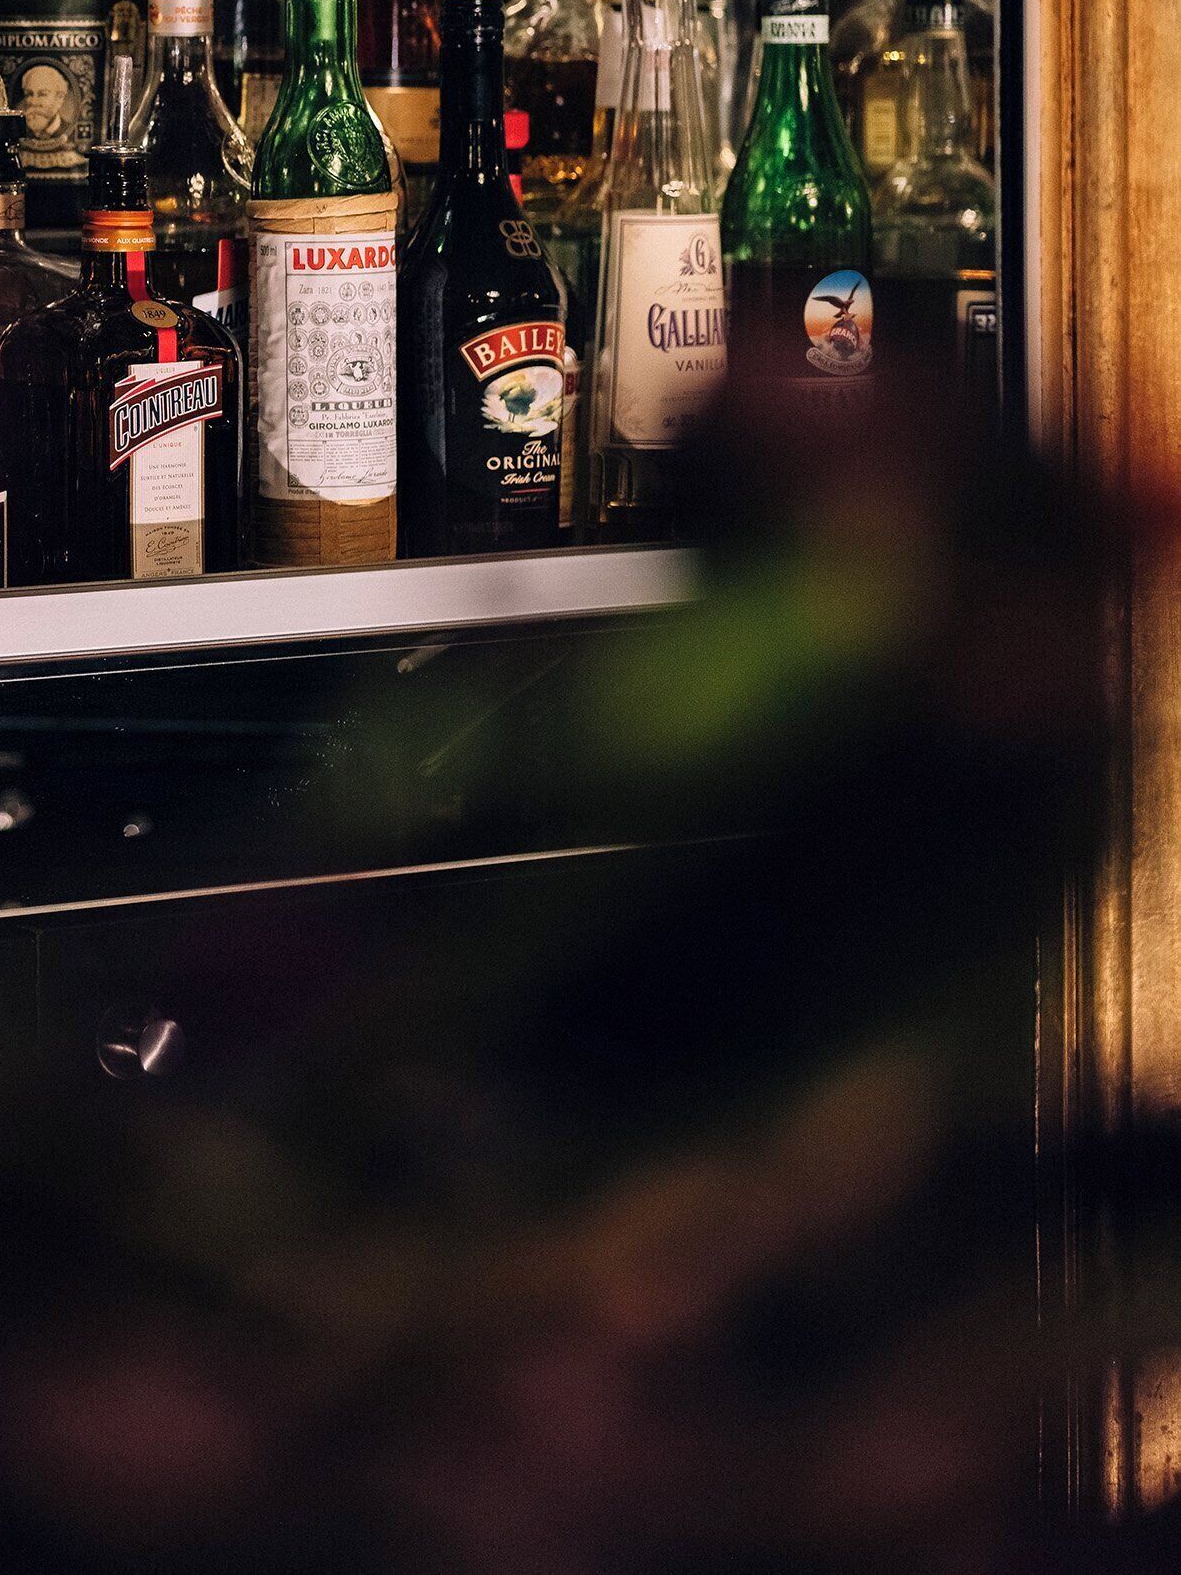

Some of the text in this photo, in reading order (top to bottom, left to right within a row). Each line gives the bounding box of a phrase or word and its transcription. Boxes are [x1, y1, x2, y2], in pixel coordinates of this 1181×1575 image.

[143, 309, 167, 319] 1849
[312, 397, 392, 412] LIQUEUR
[114, 376, 217, 452] COINTREAU
[309, 418, 394, 430] GIROLAMO LUXARDO
[522, 440, 547, 456] The
[486, 453, 561, 471] ORIGINAL
[500, 473, 531, 486] Irish
